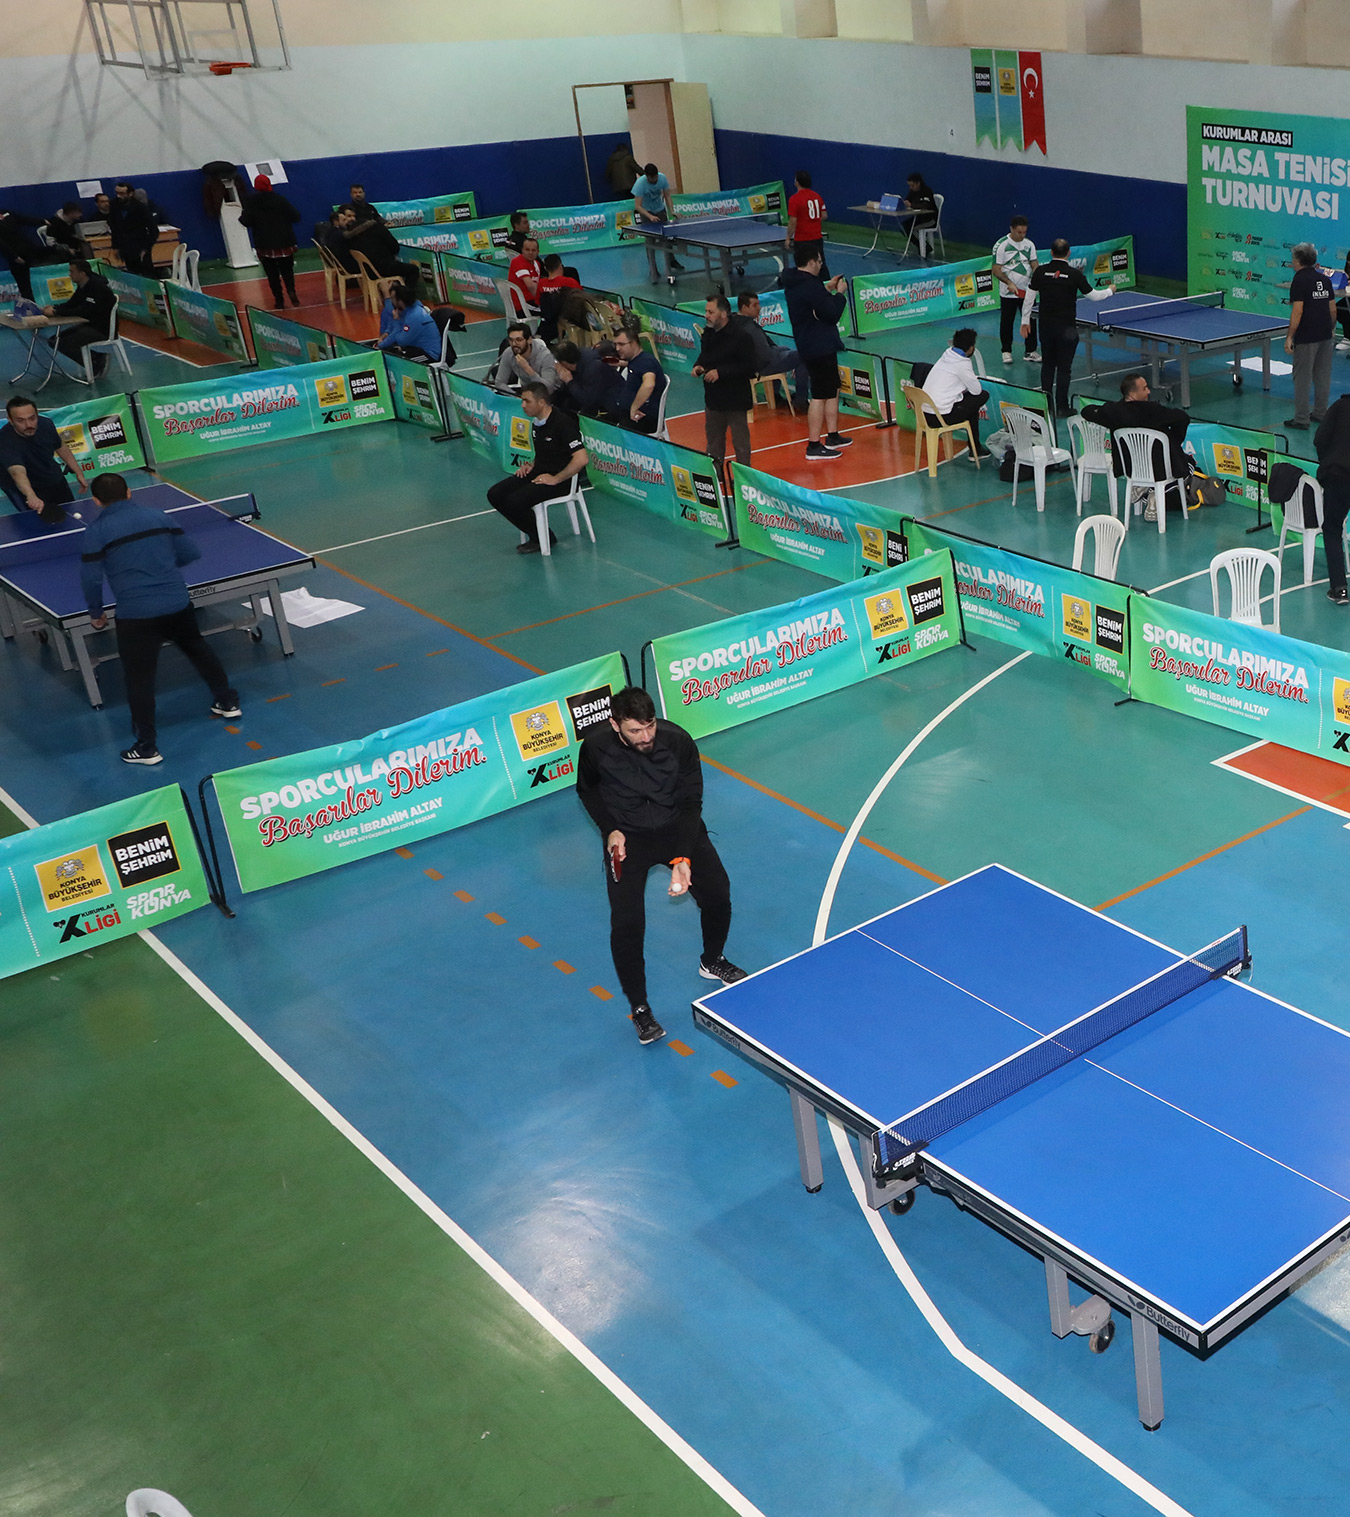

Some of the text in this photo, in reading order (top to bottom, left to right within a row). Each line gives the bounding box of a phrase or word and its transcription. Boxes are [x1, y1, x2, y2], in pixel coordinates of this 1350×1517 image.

[1202, 125, 1292, 146] KURUMLAR ARASI
[1202, 145, 1270, 178] MASA
[808, 200, 820, 219] 81
[1202, 178, 1339, 220] TURNUVASI
[880, 614, 894, 622] KONYA
[669, 608, 846, 681] SPORCULARIMIZA
[1142, 622, 1310, 690] SPORCULARIMIZA
[789, 667, 813, 682] ALTAY
[1244, 702, 1269, 717] ALTAY
[531, 729, 552, 739] KONYA
[241, 728, 484, 818] SPORCULARIMIZA
[410, 796, 443, 817] ALTAY
[60, 876, 87, 888] KONYA
[127, 884, 175, 908] SPOR
[131, 889, 192, 920] KONYA
[1147, 1306, 1190, 1341] Butterfly
